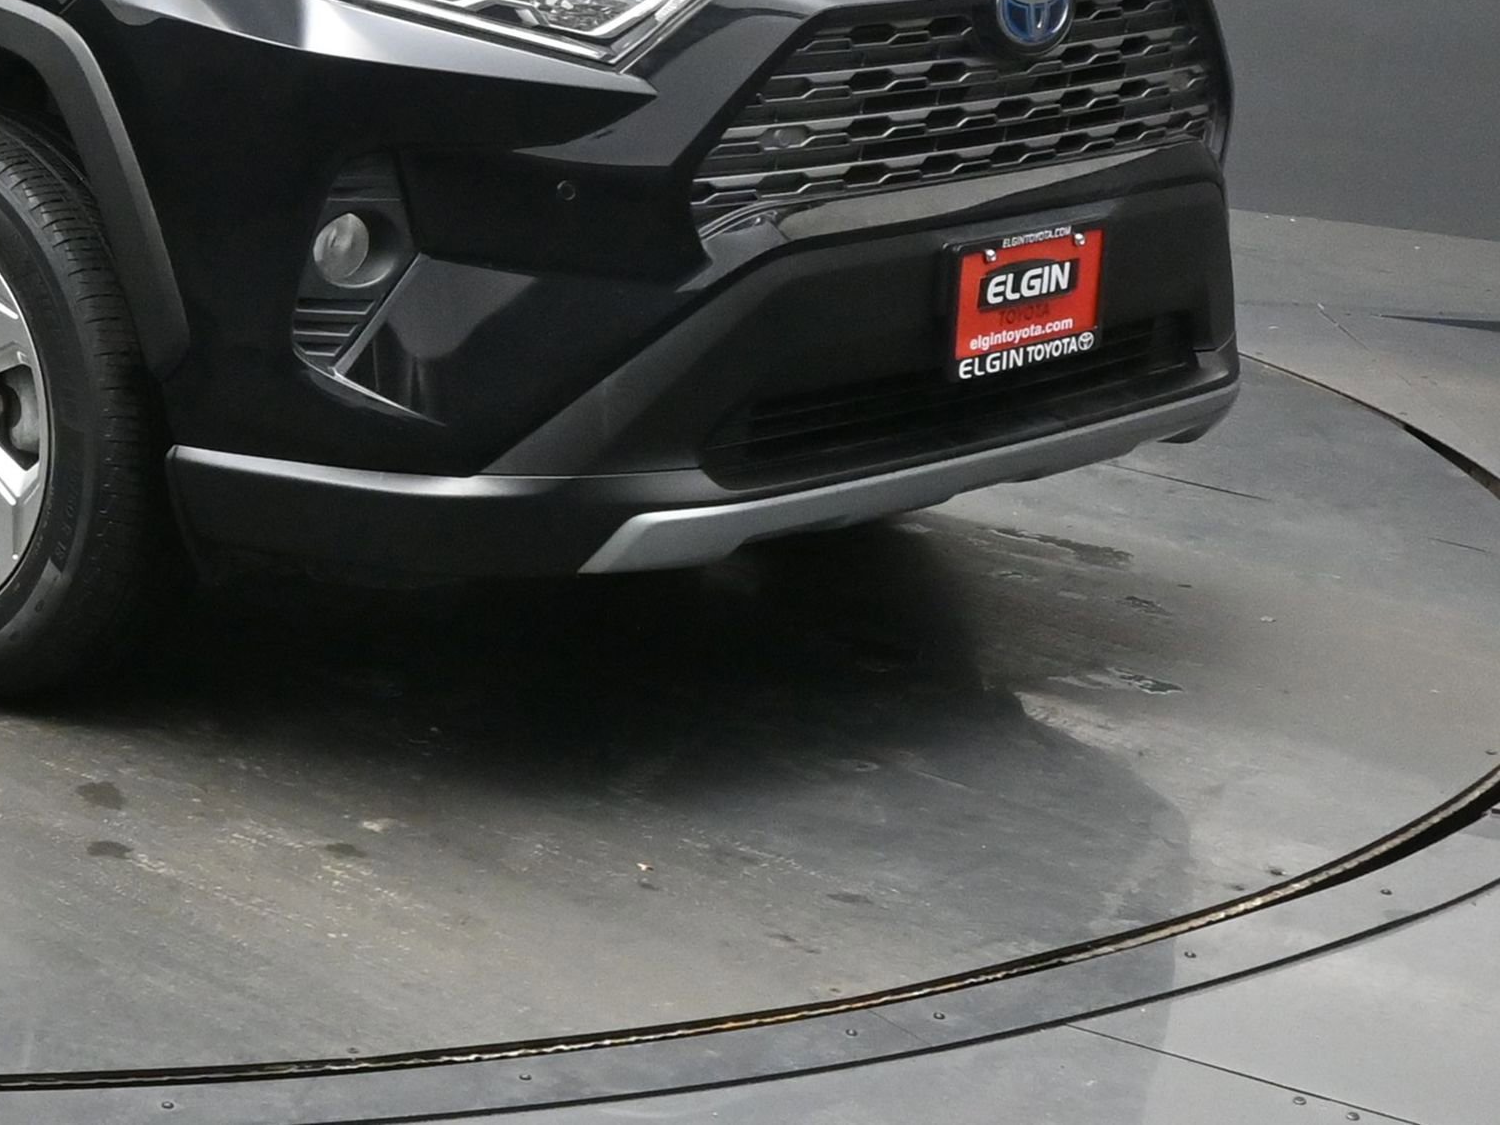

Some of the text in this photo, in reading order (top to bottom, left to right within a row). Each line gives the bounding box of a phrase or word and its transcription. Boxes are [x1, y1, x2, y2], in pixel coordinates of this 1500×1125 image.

[1002, 225, 1073, 249] ELGINTOYOTA.COM
[986, 261, 1071, 305] ELGIN
[969, 318, 1073, 350] elgintoyota.com
[958, 336, 1078, 379] ELGIN TOYOTA
